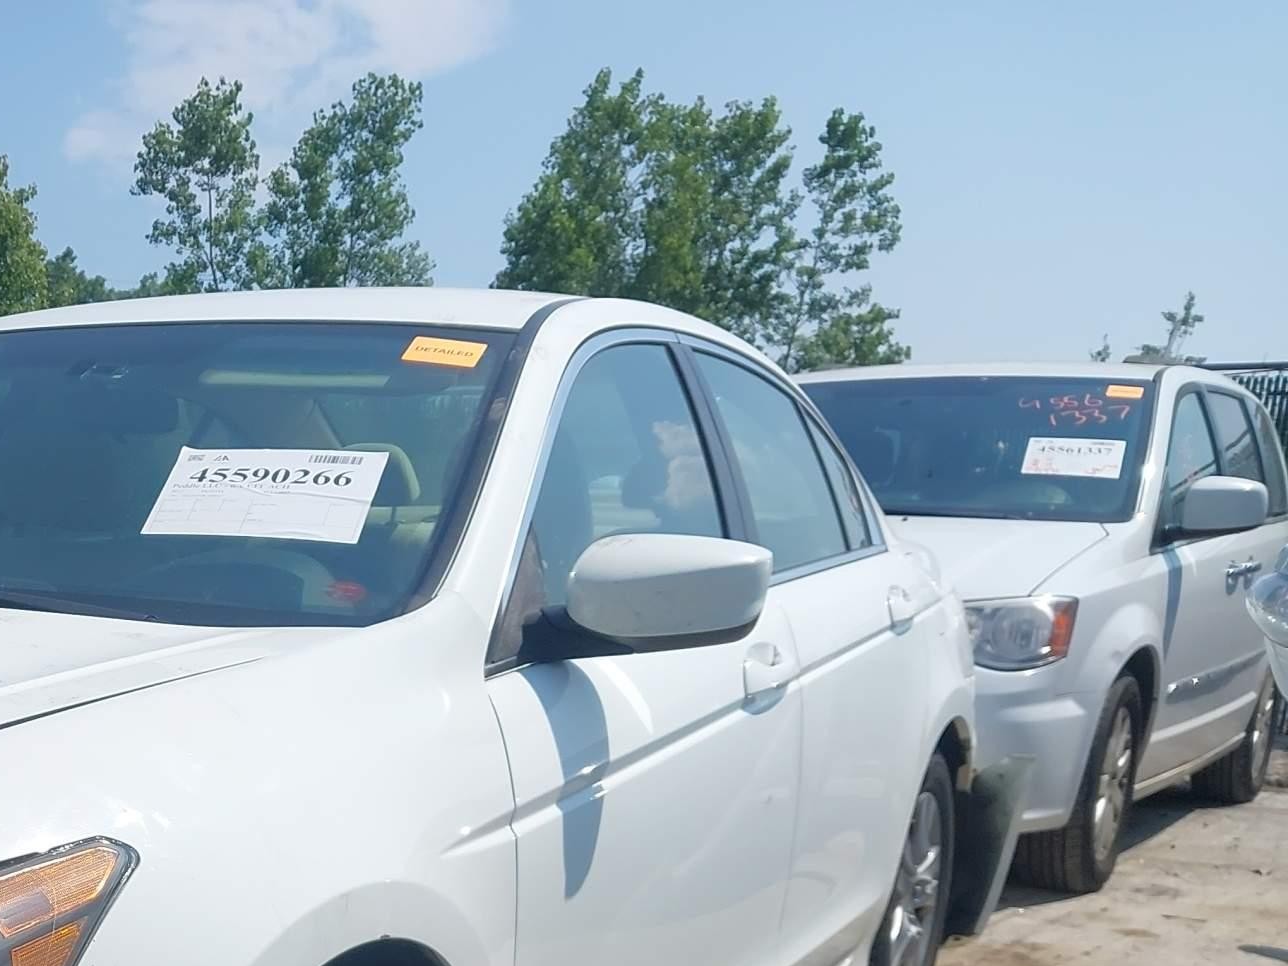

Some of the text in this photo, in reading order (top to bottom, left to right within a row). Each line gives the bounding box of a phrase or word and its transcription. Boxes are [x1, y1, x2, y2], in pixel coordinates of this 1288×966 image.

[414, 345, 475, 357] DETAILED
[1049, 405, 1130, 425] 1337
[1039, 445, 1113, 456] 45561337
[189, 467, 352, 487] 45590266
